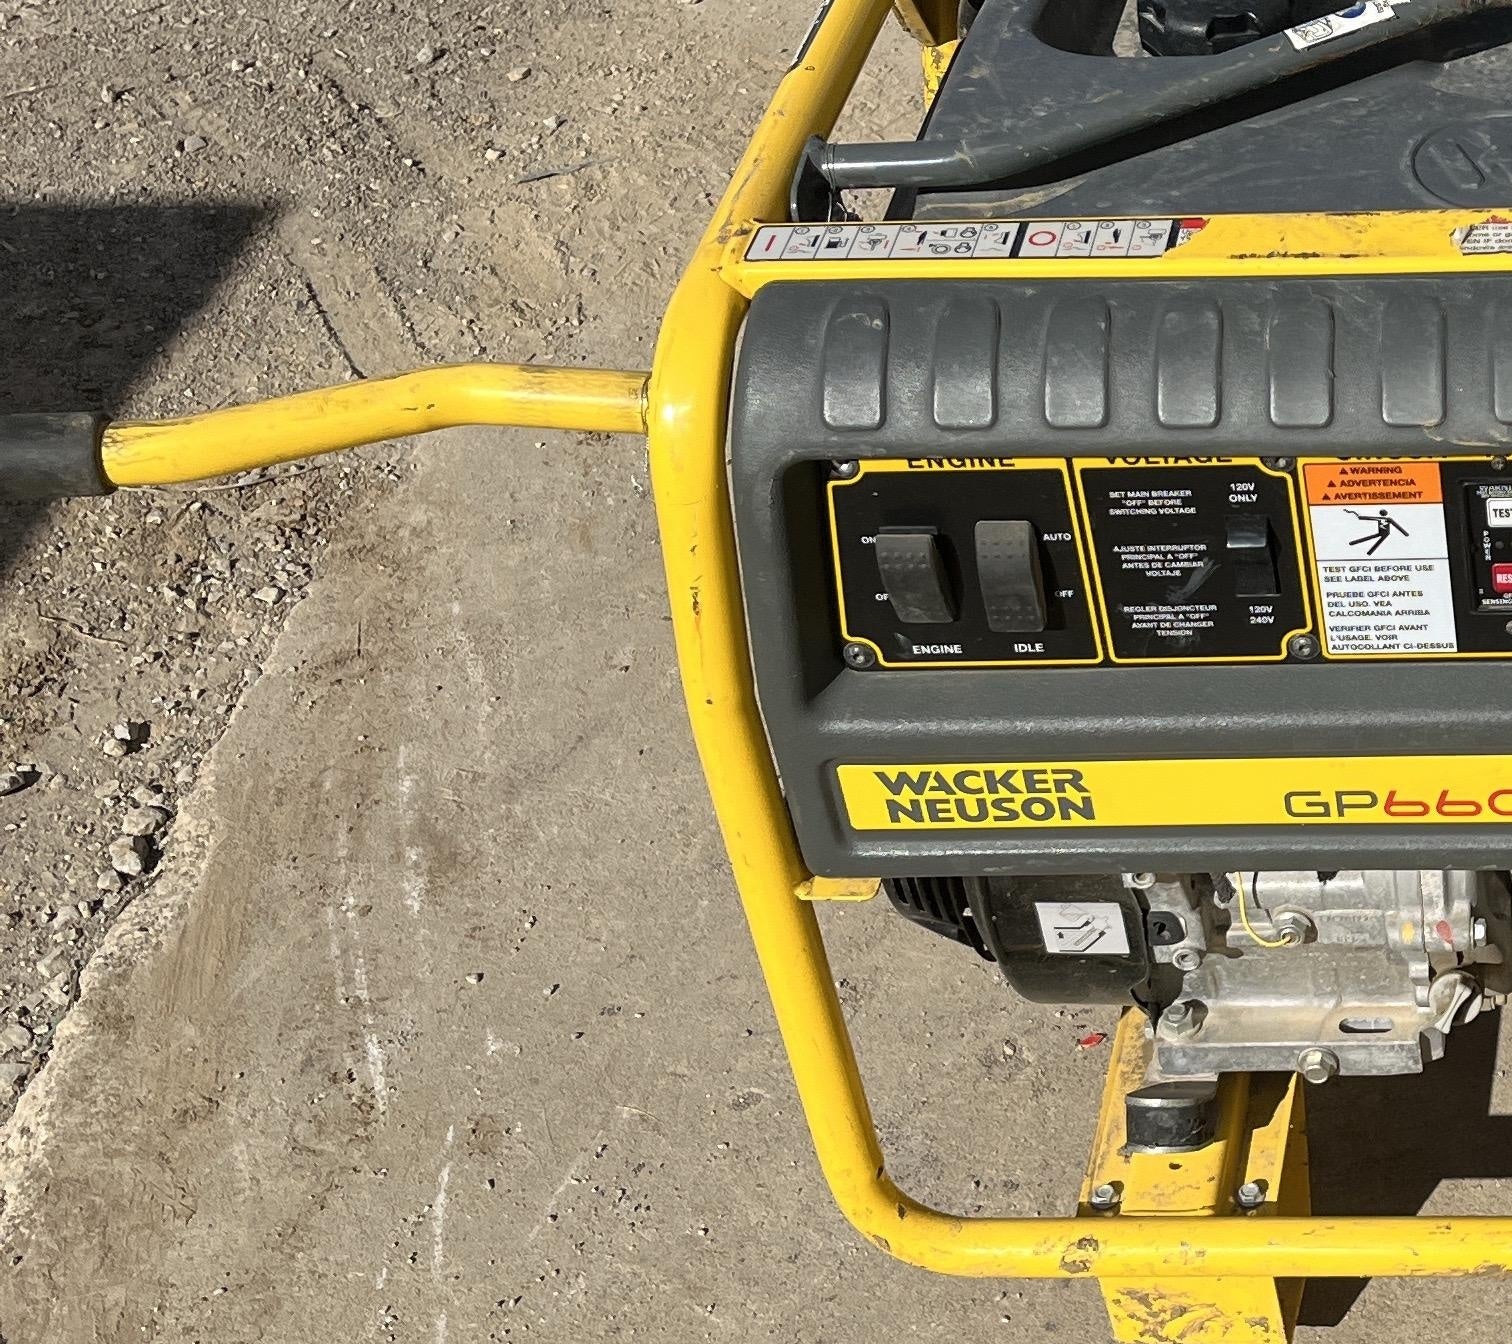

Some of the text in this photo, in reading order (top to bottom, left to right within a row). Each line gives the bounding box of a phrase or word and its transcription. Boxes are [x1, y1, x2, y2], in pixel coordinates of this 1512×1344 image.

[908, 457, 1015, 469] ENGINE
[1105, 456, 1233, 465] VOLTAGE
[1350, 466, 1402, 474] WARNING
[1230, 483, 1255, 491] 120V
[1340, 479, 1416, 487] ADVERTENCIA
[1229, 494, 1258, 503] ONLY
[1334, 491, 1423, 500] AVERTISSEMENT
[1043, 533, 1072, 541] AUTO
[1055, 590, 1074, 598] OFF
[912, 645, 963, 654] ENGINE
[1014, 643, 1045, 653] IDLE
[873, 769, 1089, 796] WACKER
[886, 795, 1095, 822] NEUSON
